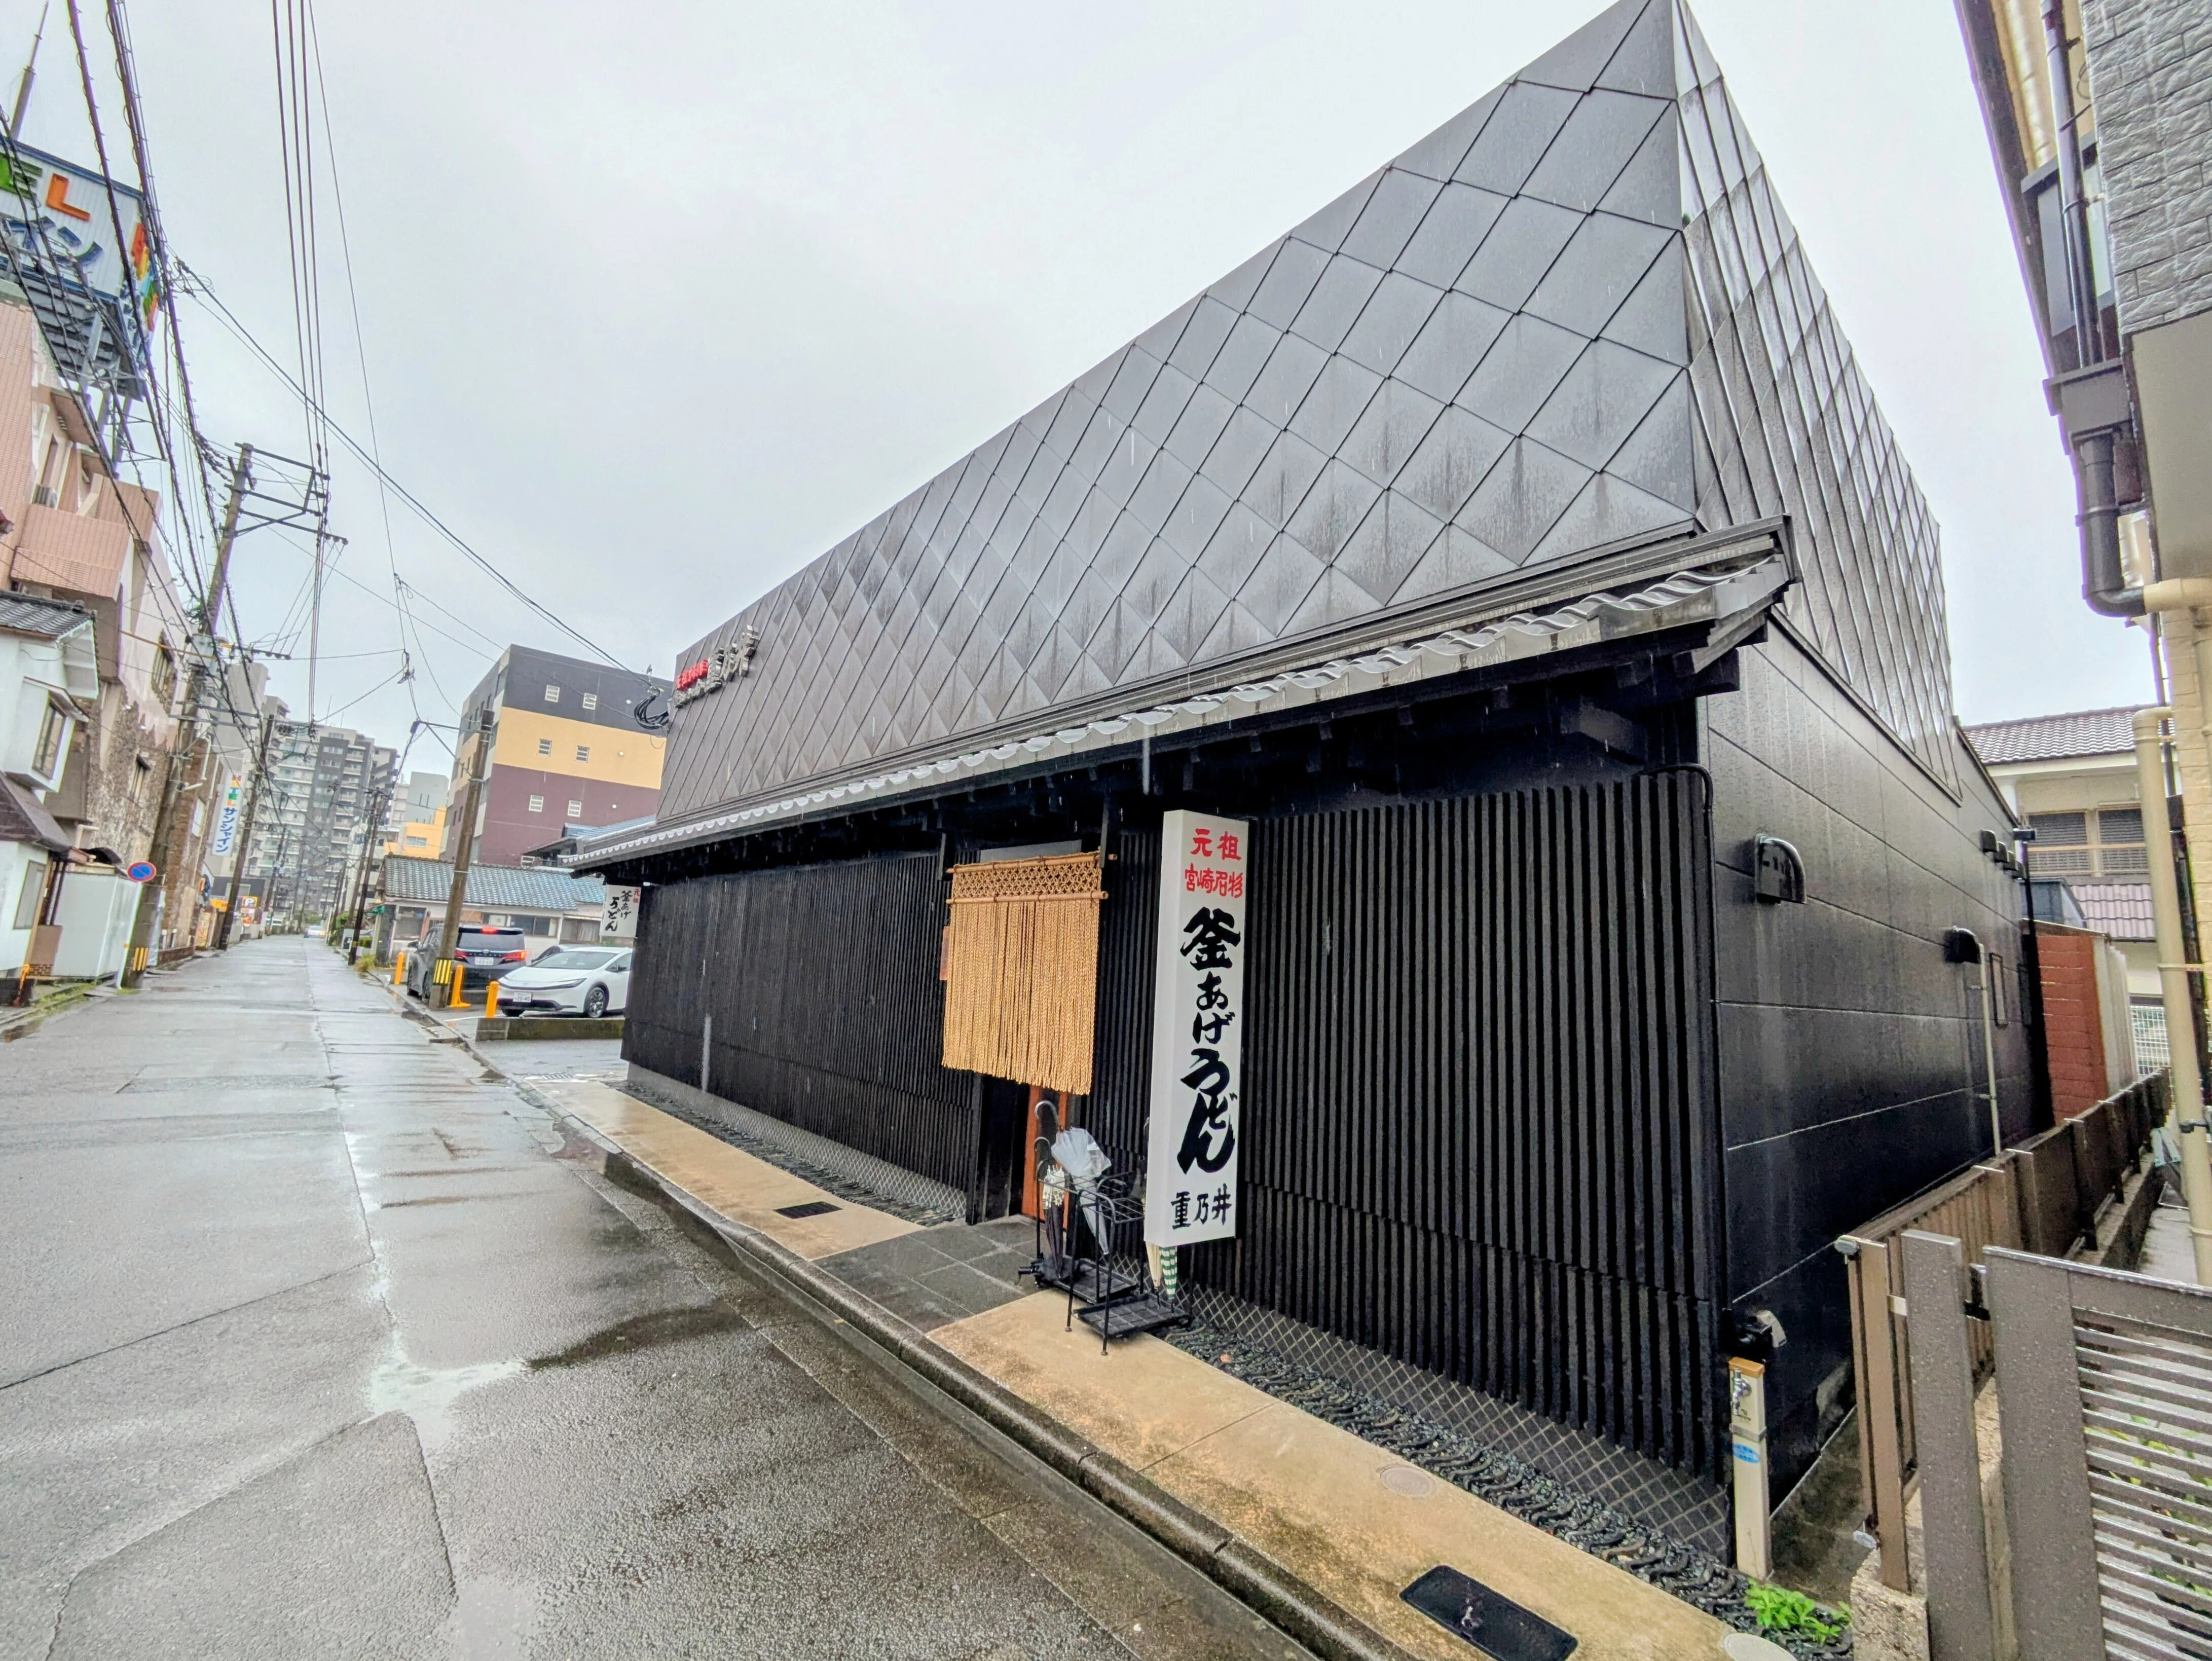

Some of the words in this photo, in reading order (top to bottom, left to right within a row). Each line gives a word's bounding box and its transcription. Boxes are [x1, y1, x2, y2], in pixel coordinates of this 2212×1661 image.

[216, 807, 237, 853] サンシャイン
[1191, 828, 1241, 861] 元祖
[1185, 863, 1243, 899] 宮崎名物
[605, 897, 621, 932] うどん
[1177, 906, 1241, 1174] 釜あげうどん
[1171, 1183, 1232, 1230] 重乃井
